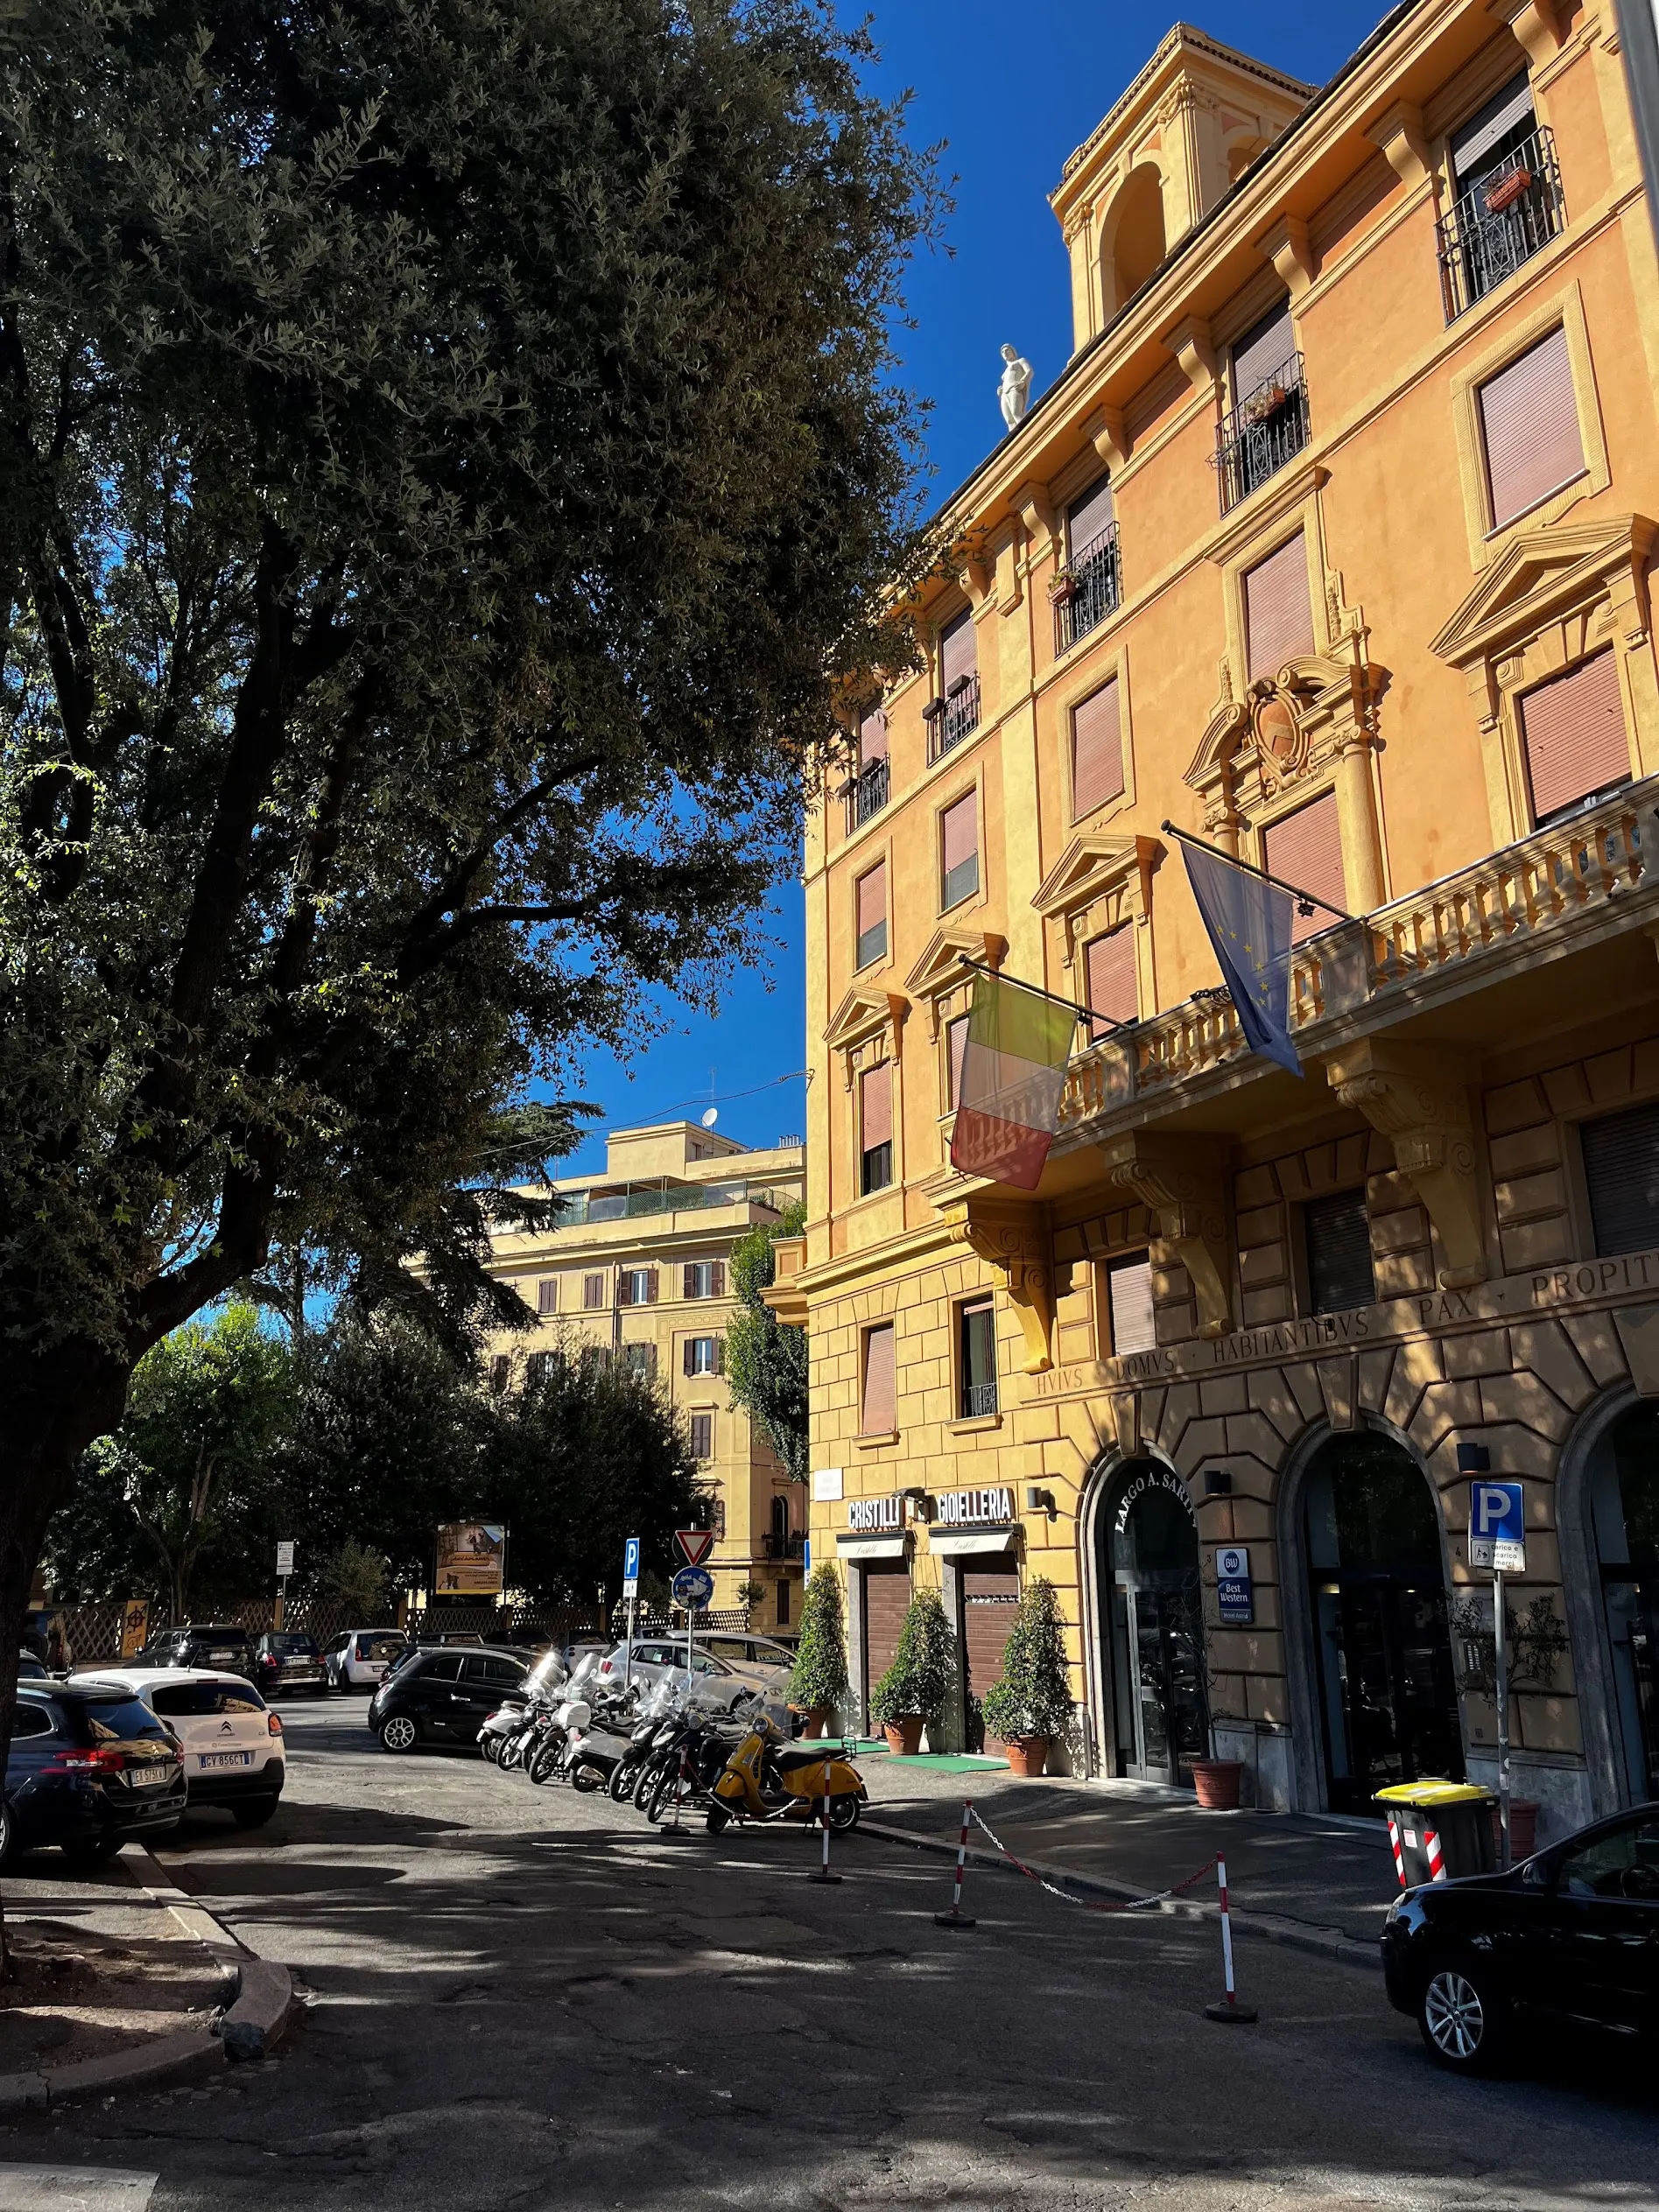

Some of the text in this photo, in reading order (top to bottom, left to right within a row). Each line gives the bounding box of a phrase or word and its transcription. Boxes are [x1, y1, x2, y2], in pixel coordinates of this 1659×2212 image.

[1037, 1253, 1659, 1394] HVIVS DOMVS HABITANTIBVS PAX PROPIT
[847, 1497, 900, 1529] CRISTILLI
[938, 1487, 1011, 1524] GIOIELLERIA
[1114, 1477, 1145, 1534] LARGO
[1147, 1471, 1160, 1487] A.
[1480, 1487, 1512, 1533] P
[627, 1543, 636, 1575] P
[1226, 1557, 1239, 1569] BW
[1220, 1592, 1248, 1602] Western
[1226, 1584, 1241, 1593] Best
[206, 1754, 243, 1766] GV 856CT
